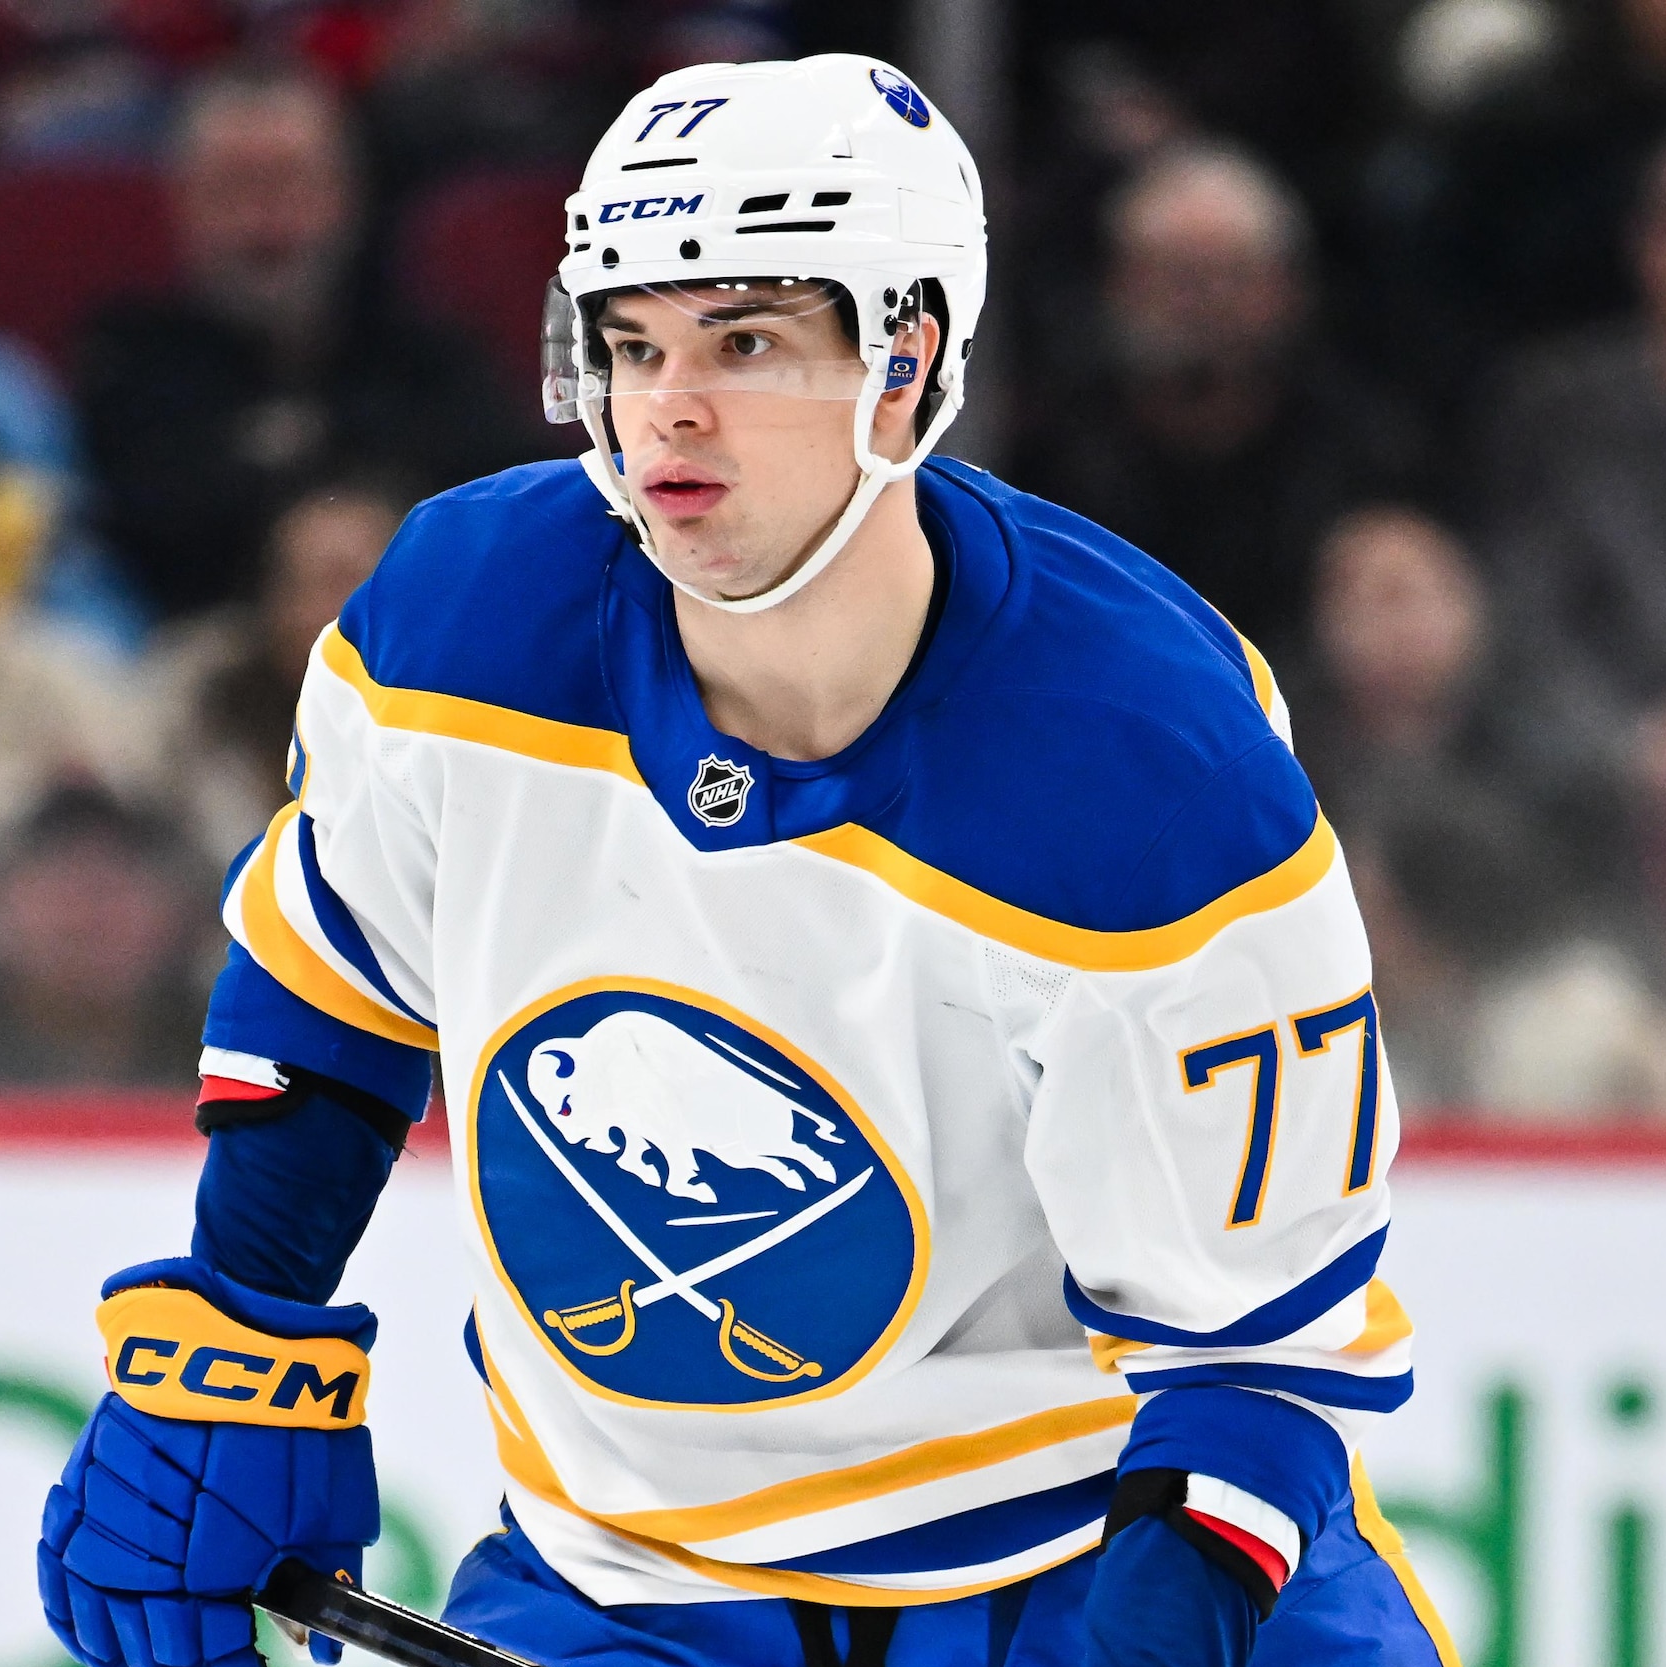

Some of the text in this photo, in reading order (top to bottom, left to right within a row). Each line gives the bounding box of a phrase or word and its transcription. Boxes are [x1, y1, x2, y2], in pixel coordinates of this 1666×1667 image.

[634, 97, 731, 143] 77
[598, 194, 704, 224] CCM
[699, 781, 740, 807] NHL
[1177, 983, 1381, 1231] 77
[115, 1335, 360, 1420] CCM
